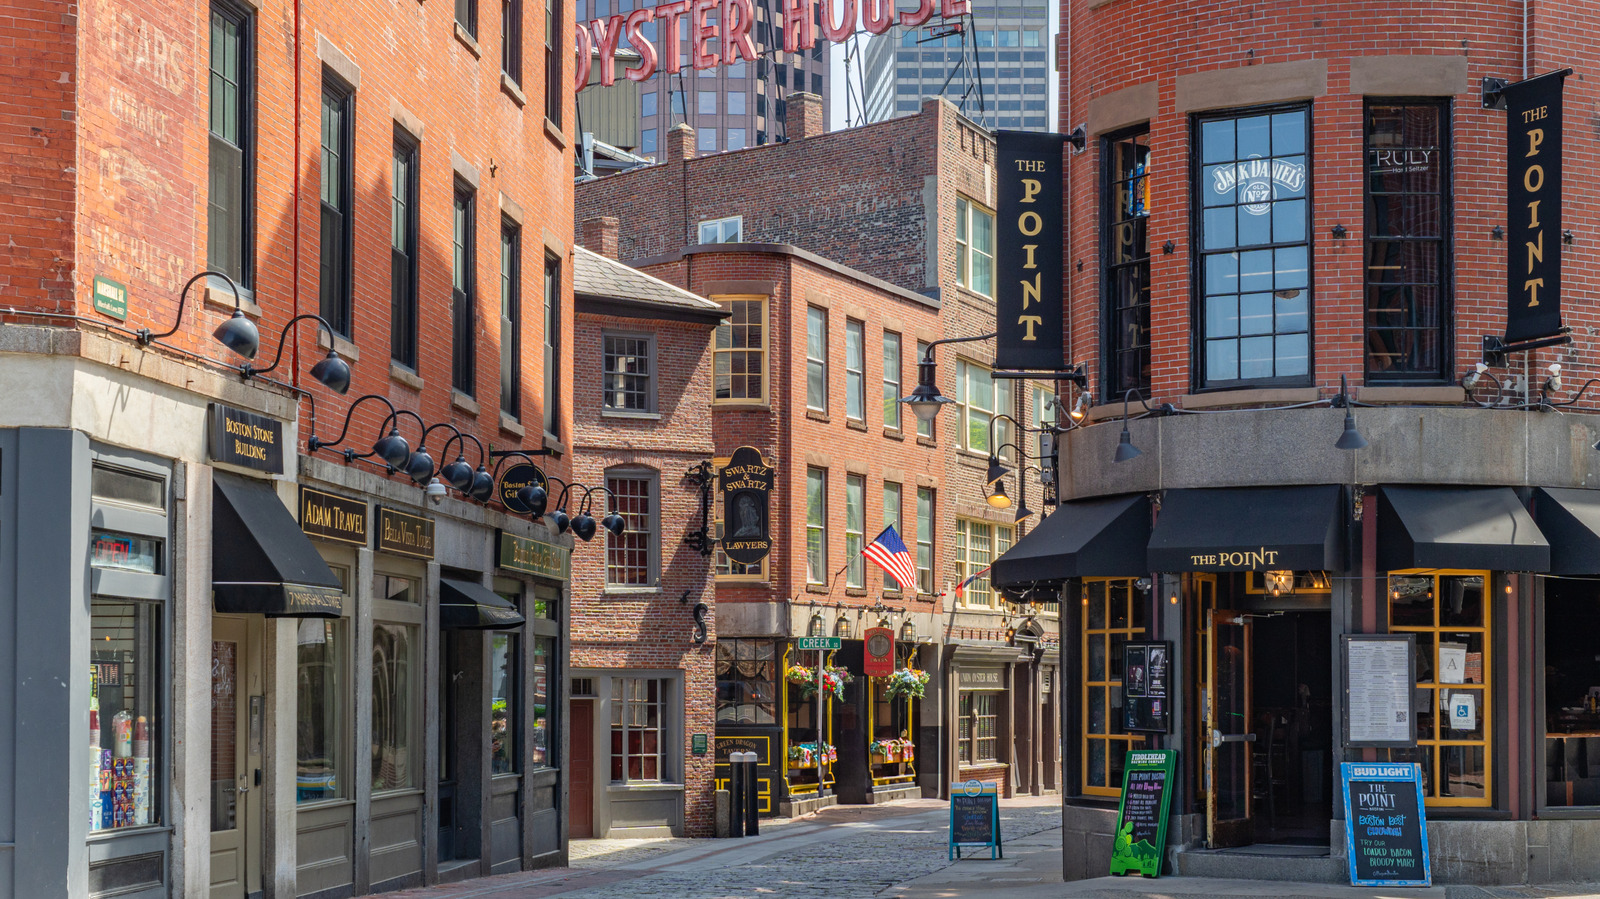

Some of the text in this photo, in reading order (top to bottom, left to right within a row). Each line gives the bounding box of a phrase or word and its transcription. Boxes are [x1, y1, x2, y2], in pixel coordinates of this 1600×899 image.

[575, 0, 971, 94] OYSTER HOU
[1522, 105, 1548, 124] THE
[1015, 159, 1046, 173] THE
[1216, 163, 1250, 191] JACK
[1524, 128, 1545, 308] POINT
[1018, 179, 1043, 341] POINT
[226, 417, 274, 444] BOSTON STONE
[235, 439, 266, 461] BUILDING
[725, 464, 767, 478] SWARTZ
[743, 473, 750, 481] &
[503, 481, 526, 489] Boston
[726, 480, 767, 491] SWARTZ
[305, 499, 364, 534] ADAM TRAVEL
[384, 517, 432, 550] BELLA VISTA TOURS
[95, 540, 129, 563] OPEN
[726, 541, 768, 550] LAWYERS
[1191, 546, 1279, 570] THE POINT
[289, 591, 295, 606] 7
[803, 638, 830, 648] CREEK
[1447, 658, 1457, 670] A
[98, 664, 119, 684] ATM
[987, 673, 999, 683] HOUSE
[716, 739, 734, 749] GREEN
[735, 739, 757, 749] DRAGON
[1131, 753, 1167, 761] FIDDLEHEAD
[1354, 767, 1410, 776] BUD LIGHT
[1369, 784, 1387, 793] THE
[1359, 793, 1396, 808] POINT
[1373, 839, 1386, 847] OUR
[1363, 847, 1413, 857] LOADED BACON
[1369, 857, 1415, 868] BLOODY MARY
